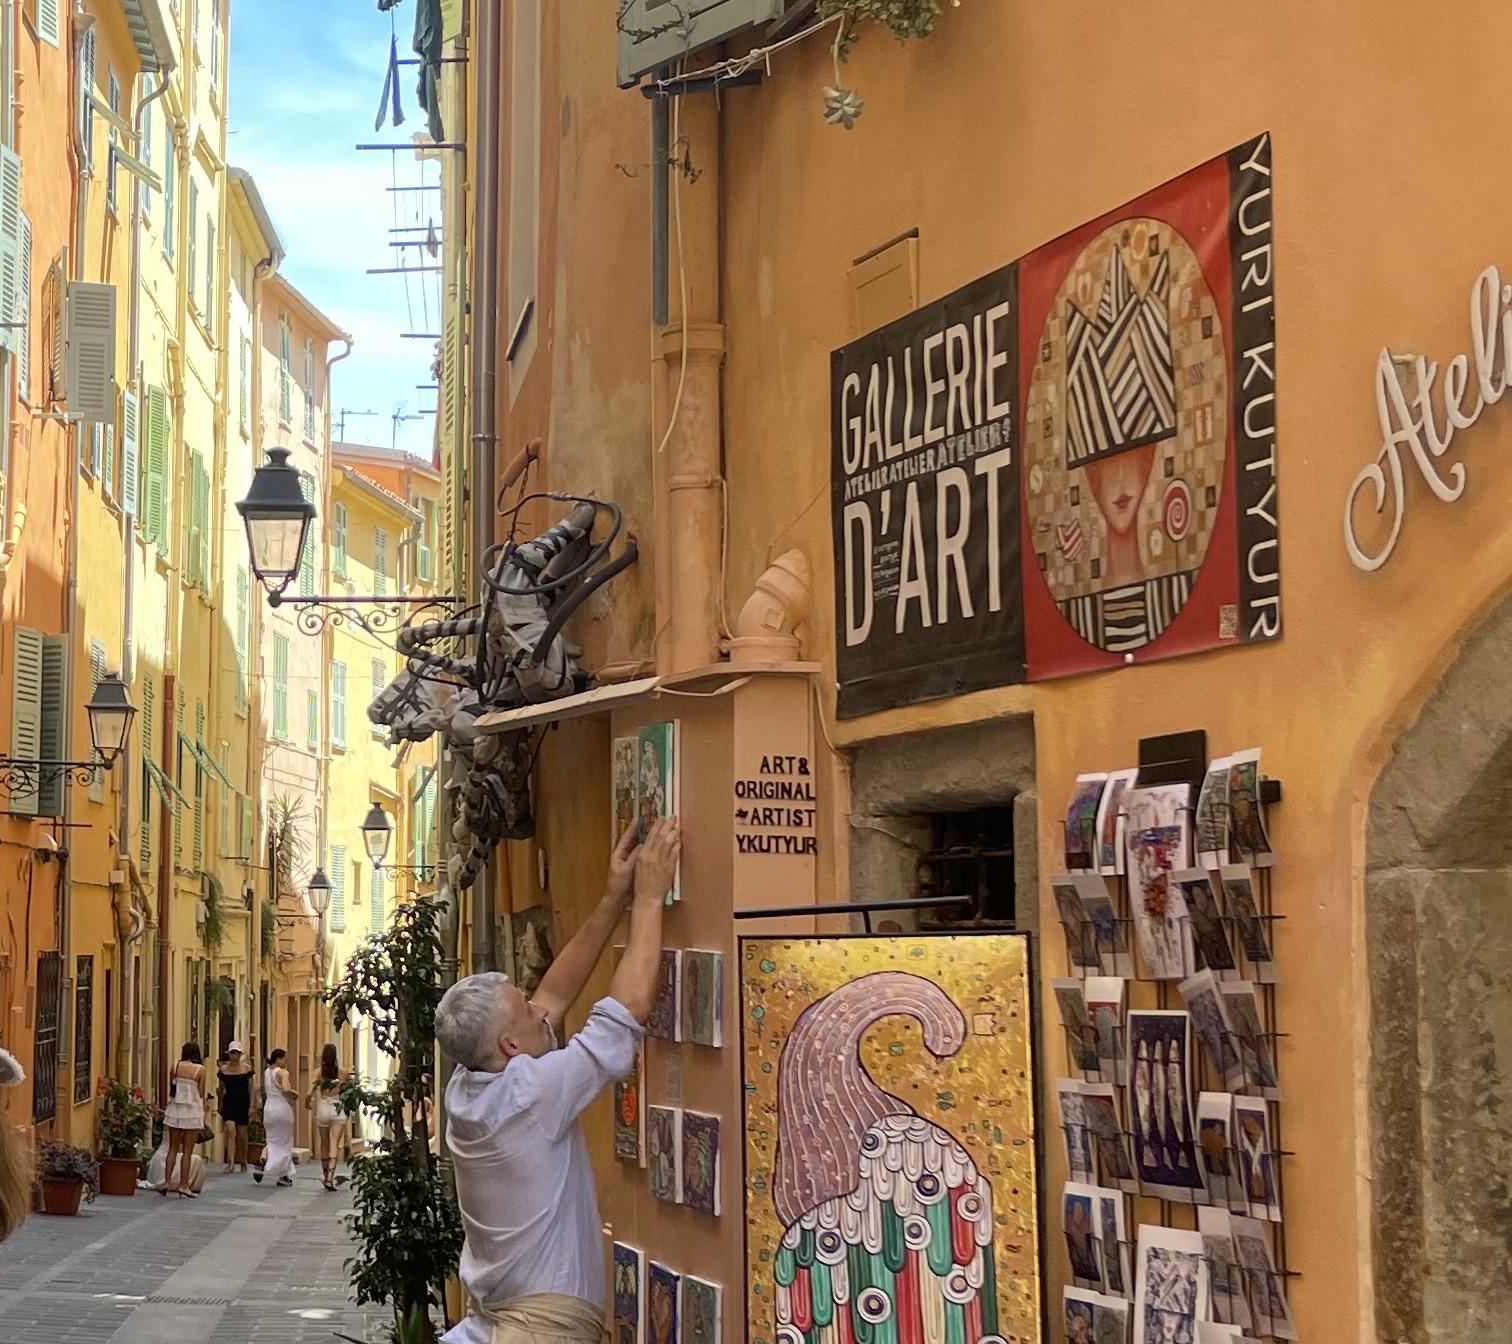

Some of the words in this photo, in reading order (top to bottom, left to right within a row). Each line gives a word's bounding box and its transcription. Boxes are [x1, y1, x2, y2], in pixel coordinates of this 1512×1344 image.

[1239, 133, 1273, 314] YURI
[841, 301, 1011, 475] GALLERIE
[843, 447, 1012, 646] D'ART
[1242, 341, 1281, 639] KUTYUR
[735, 780, 817, 801] ORIGINAL
[750, 807, 817, 828] ARTIST
